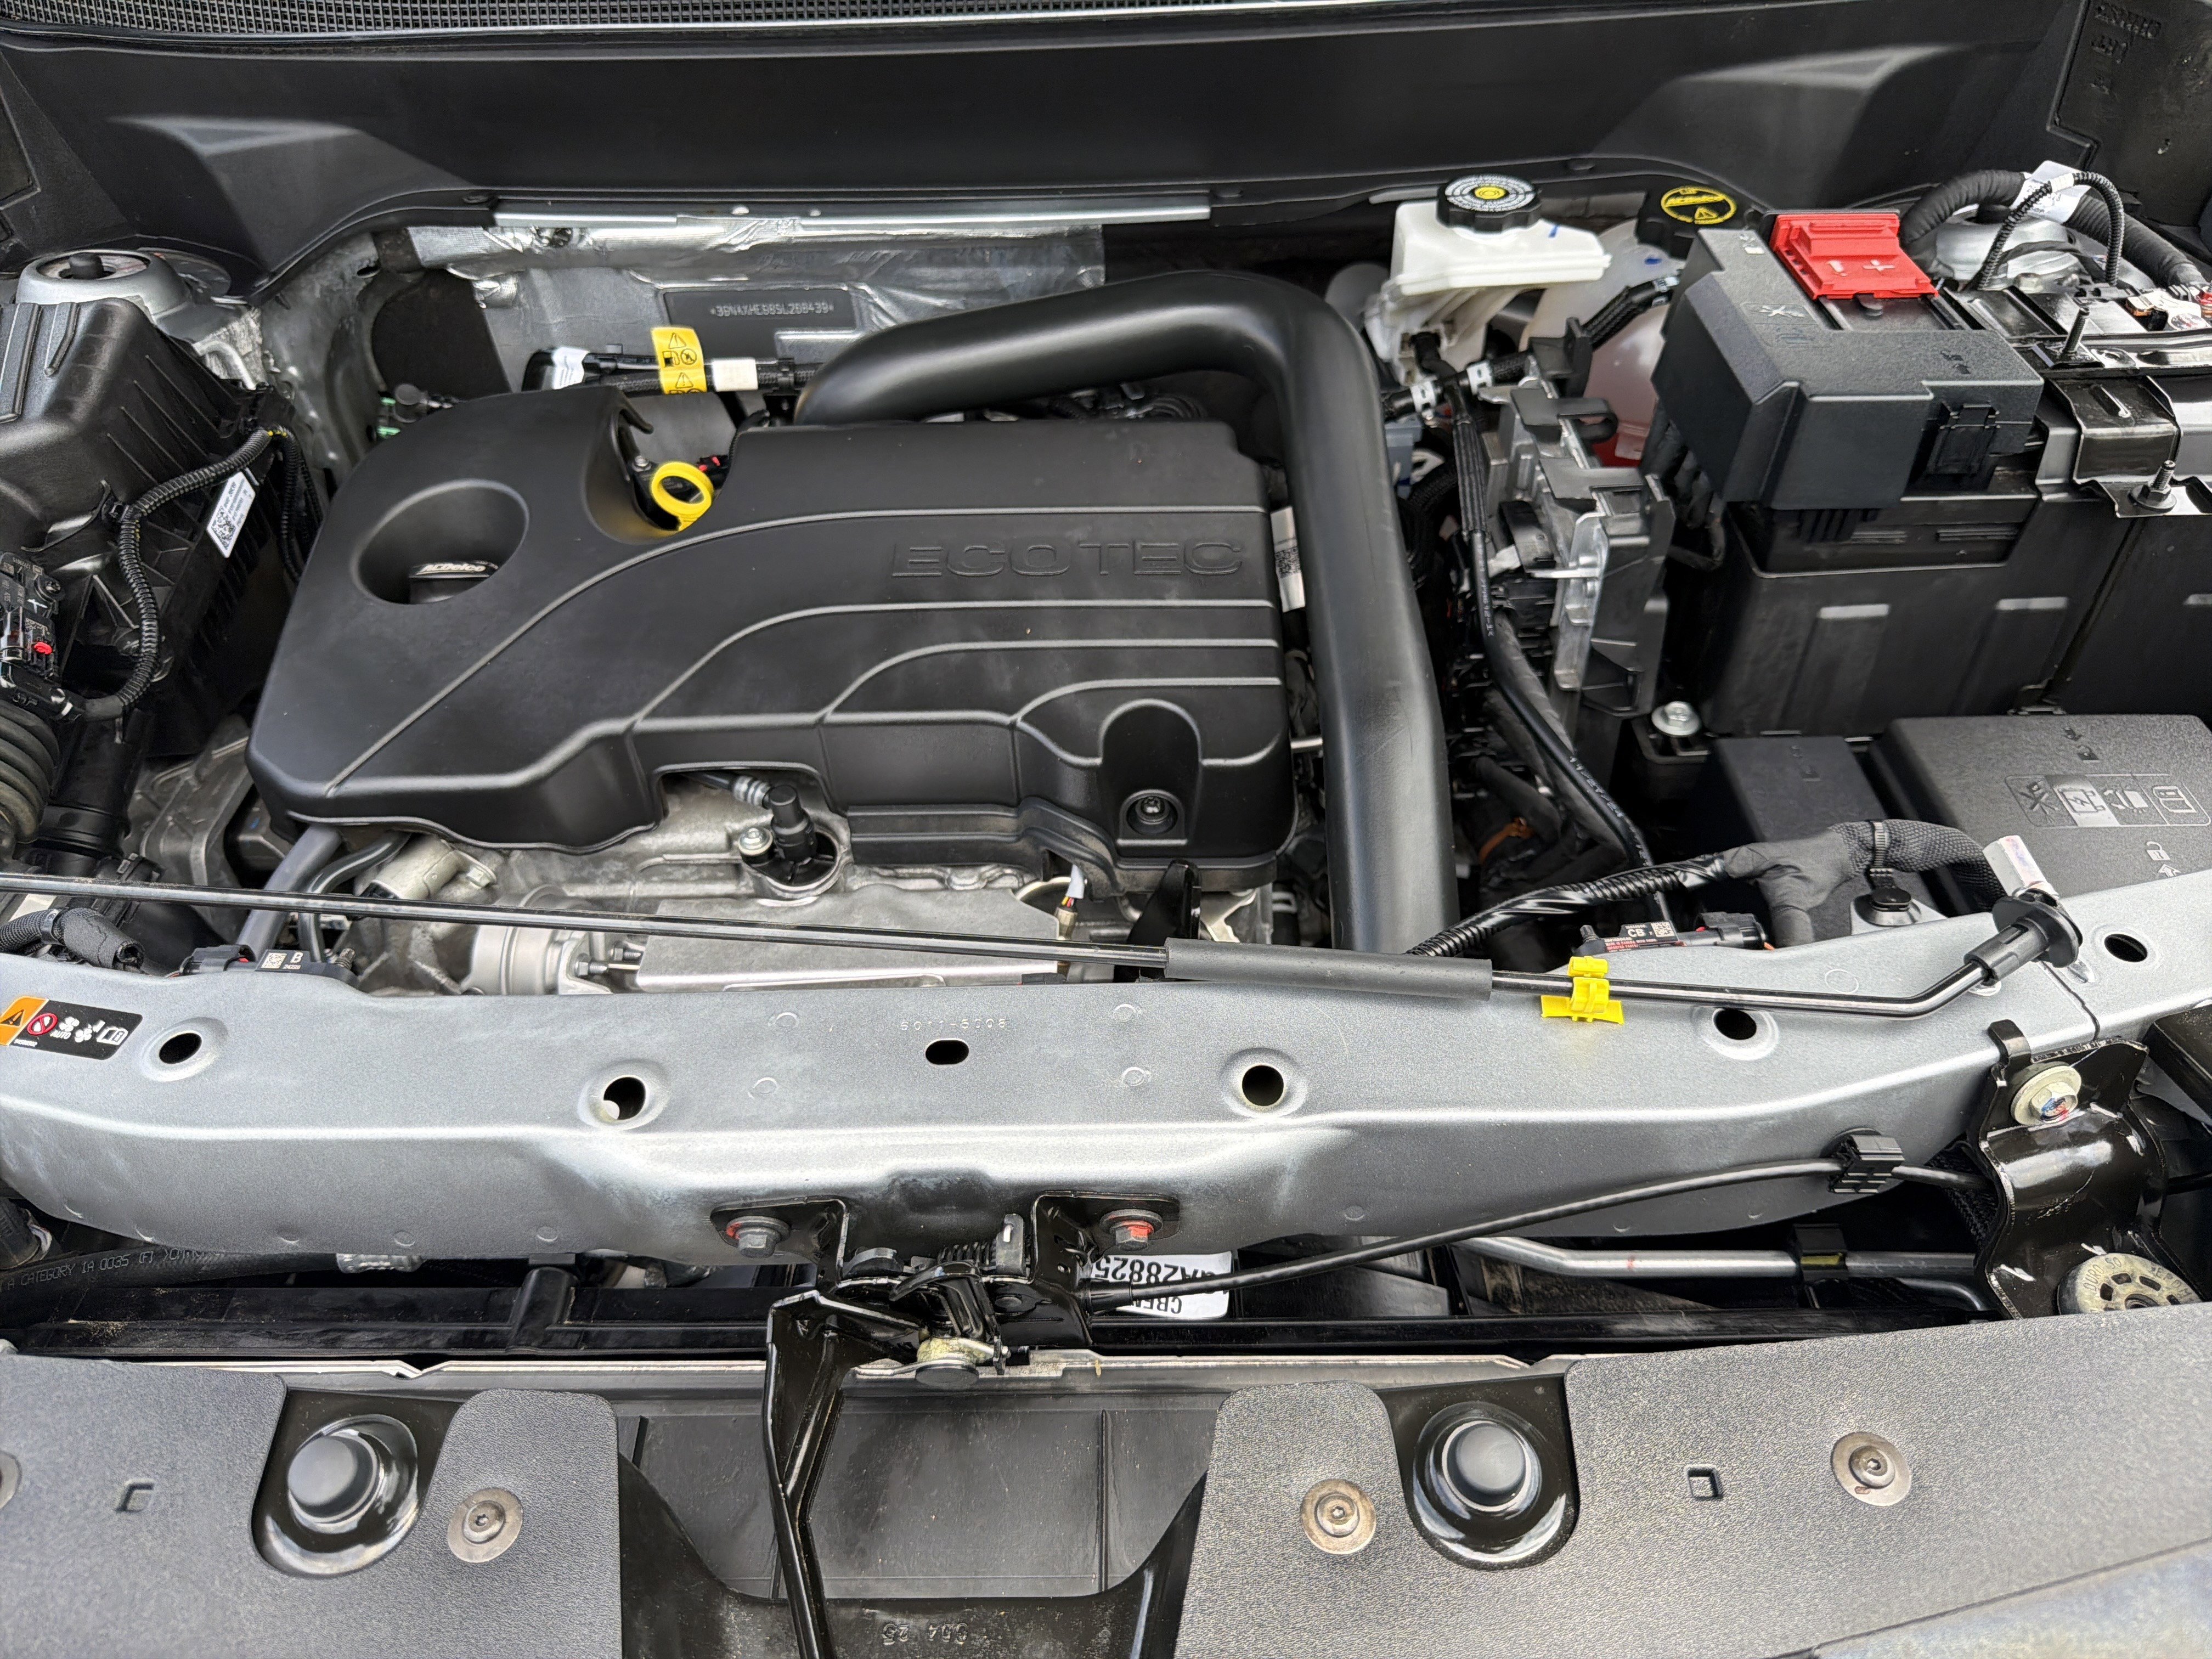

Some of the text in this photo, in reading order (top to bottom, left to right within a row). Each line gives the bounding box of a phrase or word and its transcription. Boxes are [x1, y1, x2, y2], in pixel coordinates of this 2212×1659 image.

[891, 538, 1245, 579] ECOTEC
[419, 562, 486, 572] ACDelco
[1627, 928, 1646, 938] CB
[290, 952, 303, 963] B
[50, 1029, 72, 1040] AUTO
[20, 1263, 76, 1286] CATEGORY
